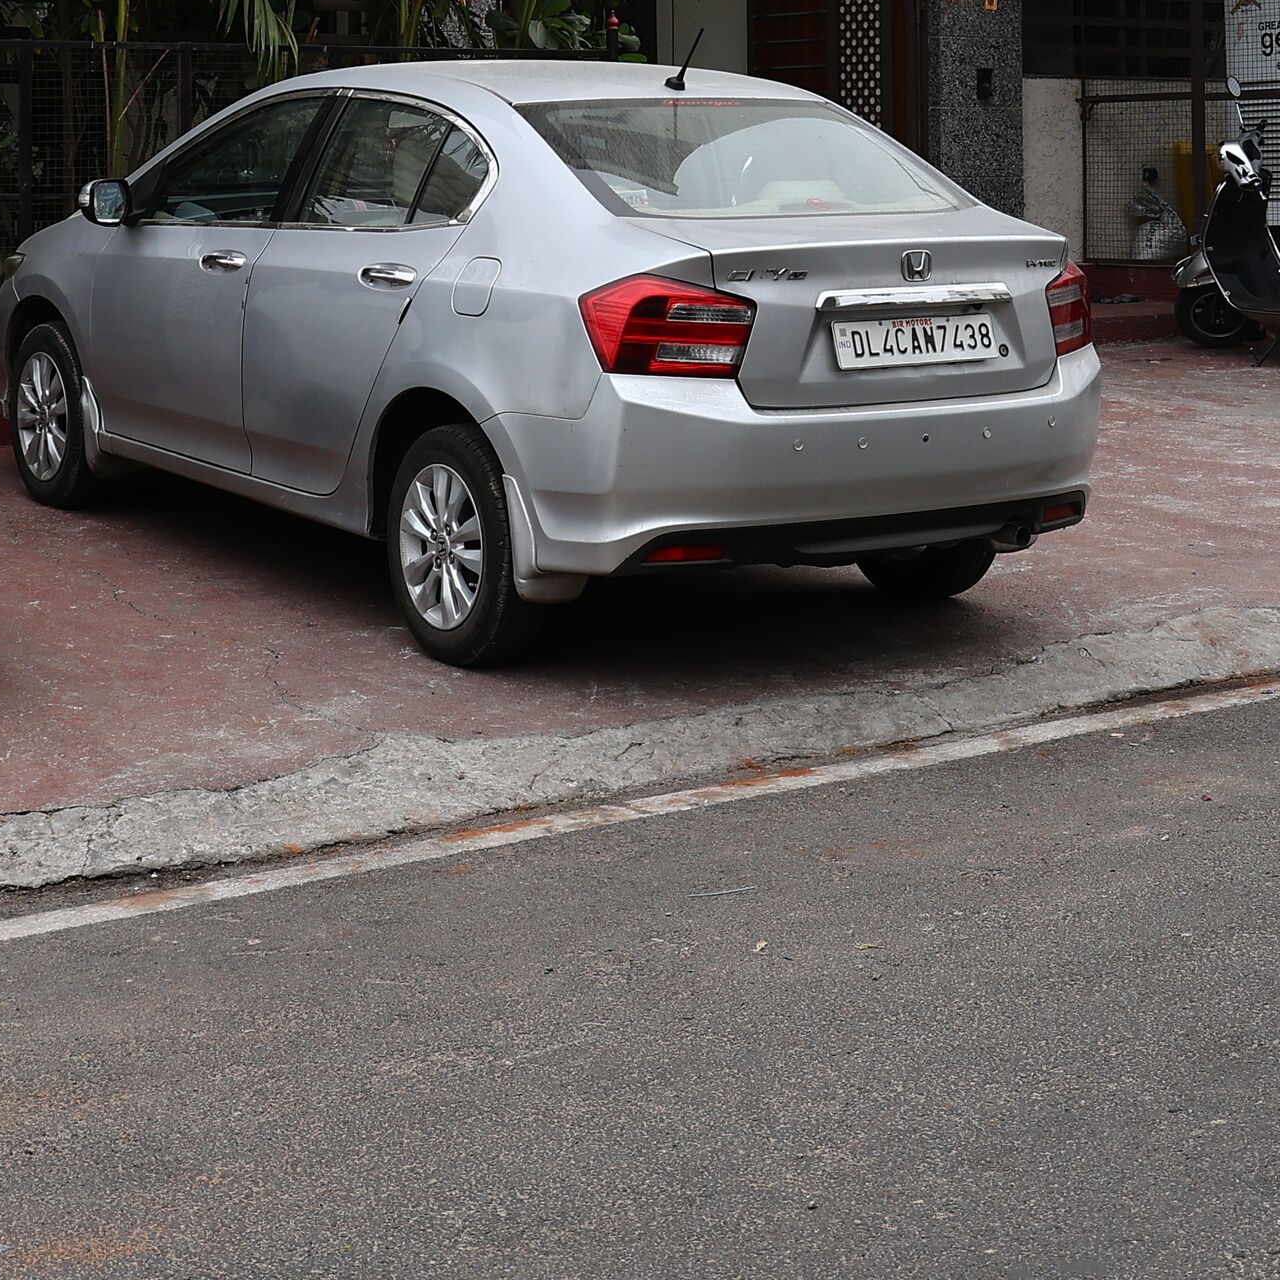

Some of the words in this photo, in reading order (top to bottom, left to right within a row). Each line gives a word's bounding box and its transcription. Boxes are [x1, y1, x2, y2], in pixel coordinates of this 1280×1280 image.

[905, 318, 933, 328] MOTORS
[838, 340, 851, 349] IND
[851, 322, 992, 359] DL4CAN7438
